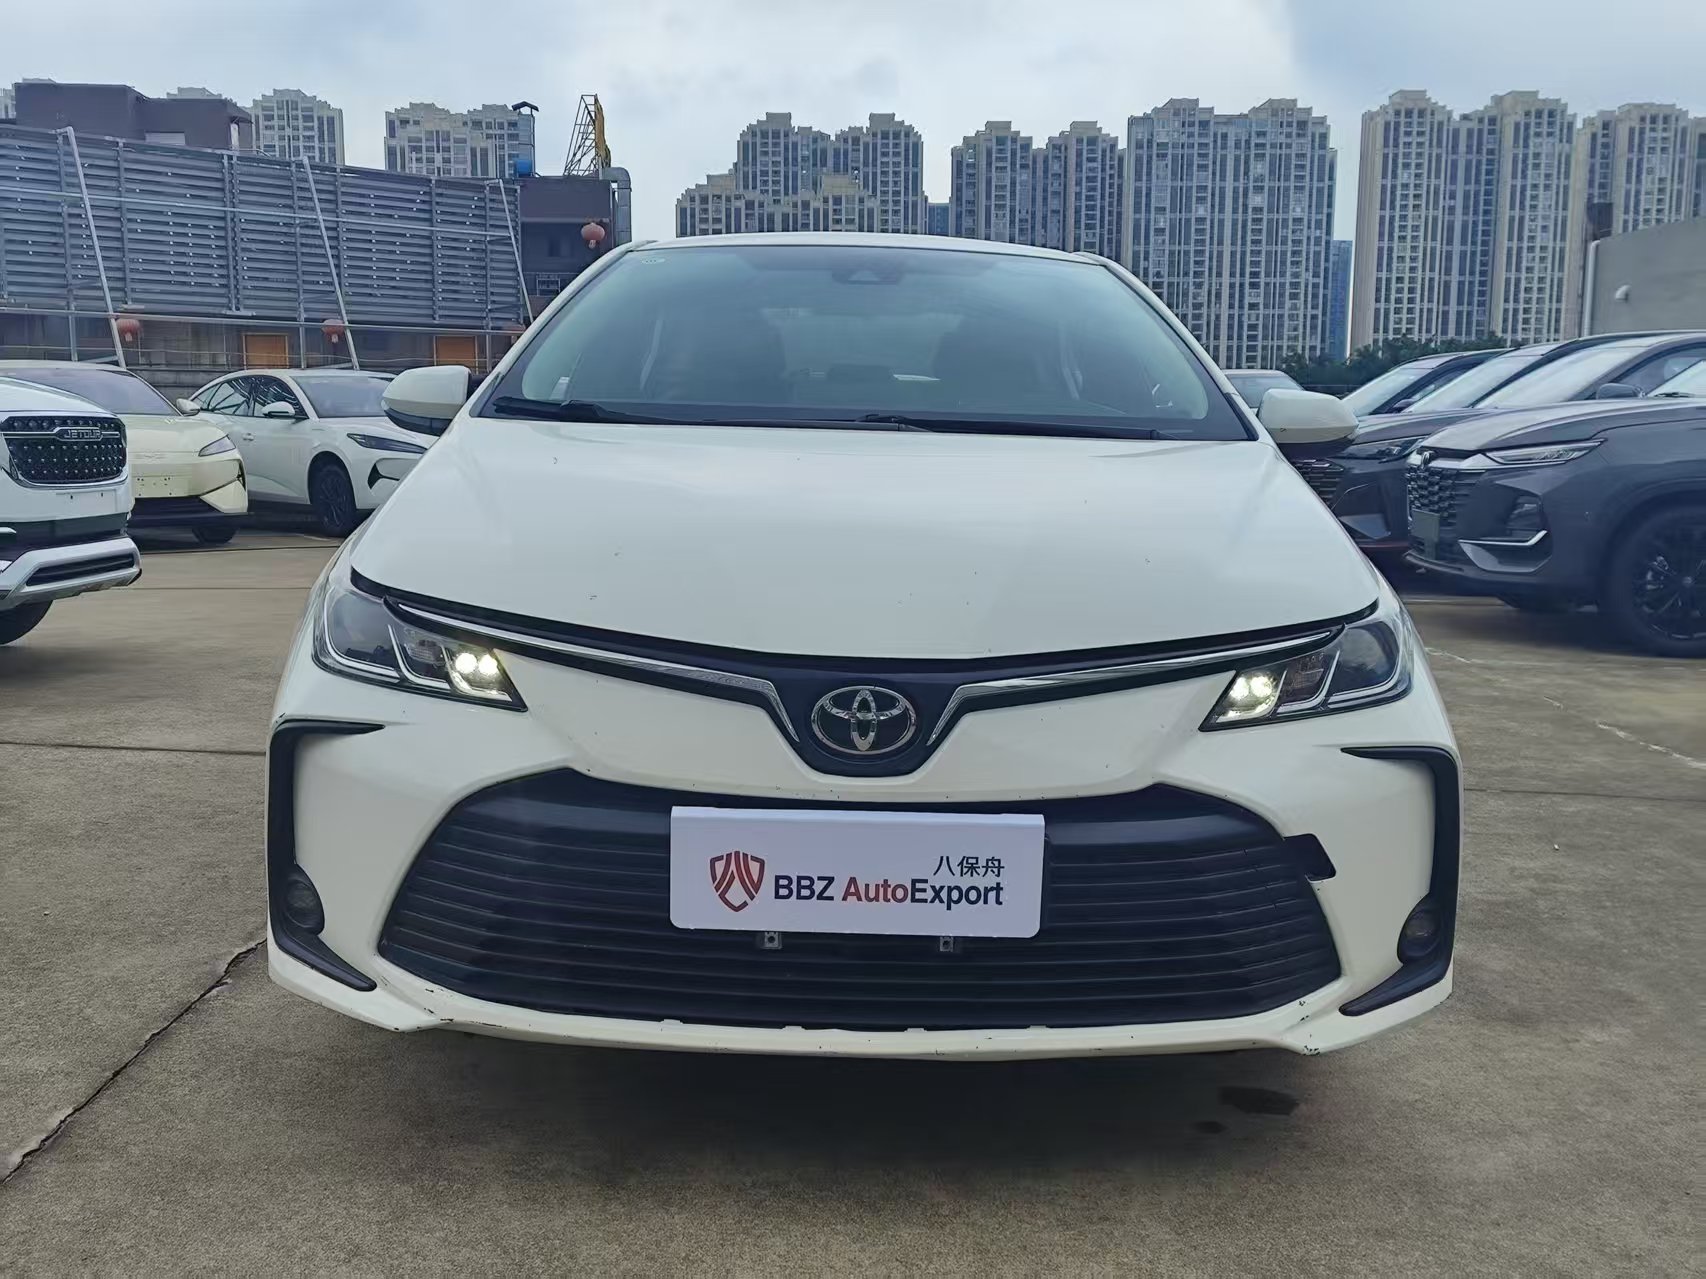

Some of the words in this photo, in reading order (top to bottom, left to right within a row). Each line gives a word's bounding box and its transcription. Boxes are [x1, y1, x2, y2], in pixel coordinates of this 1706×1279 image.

[64, 430, 101, 438] JETOUR
[932, 855, 1005, 878] 八保舟
[773, 875, 835, 901] BBZ
[841, 876, 1004, 910] AutoExport
